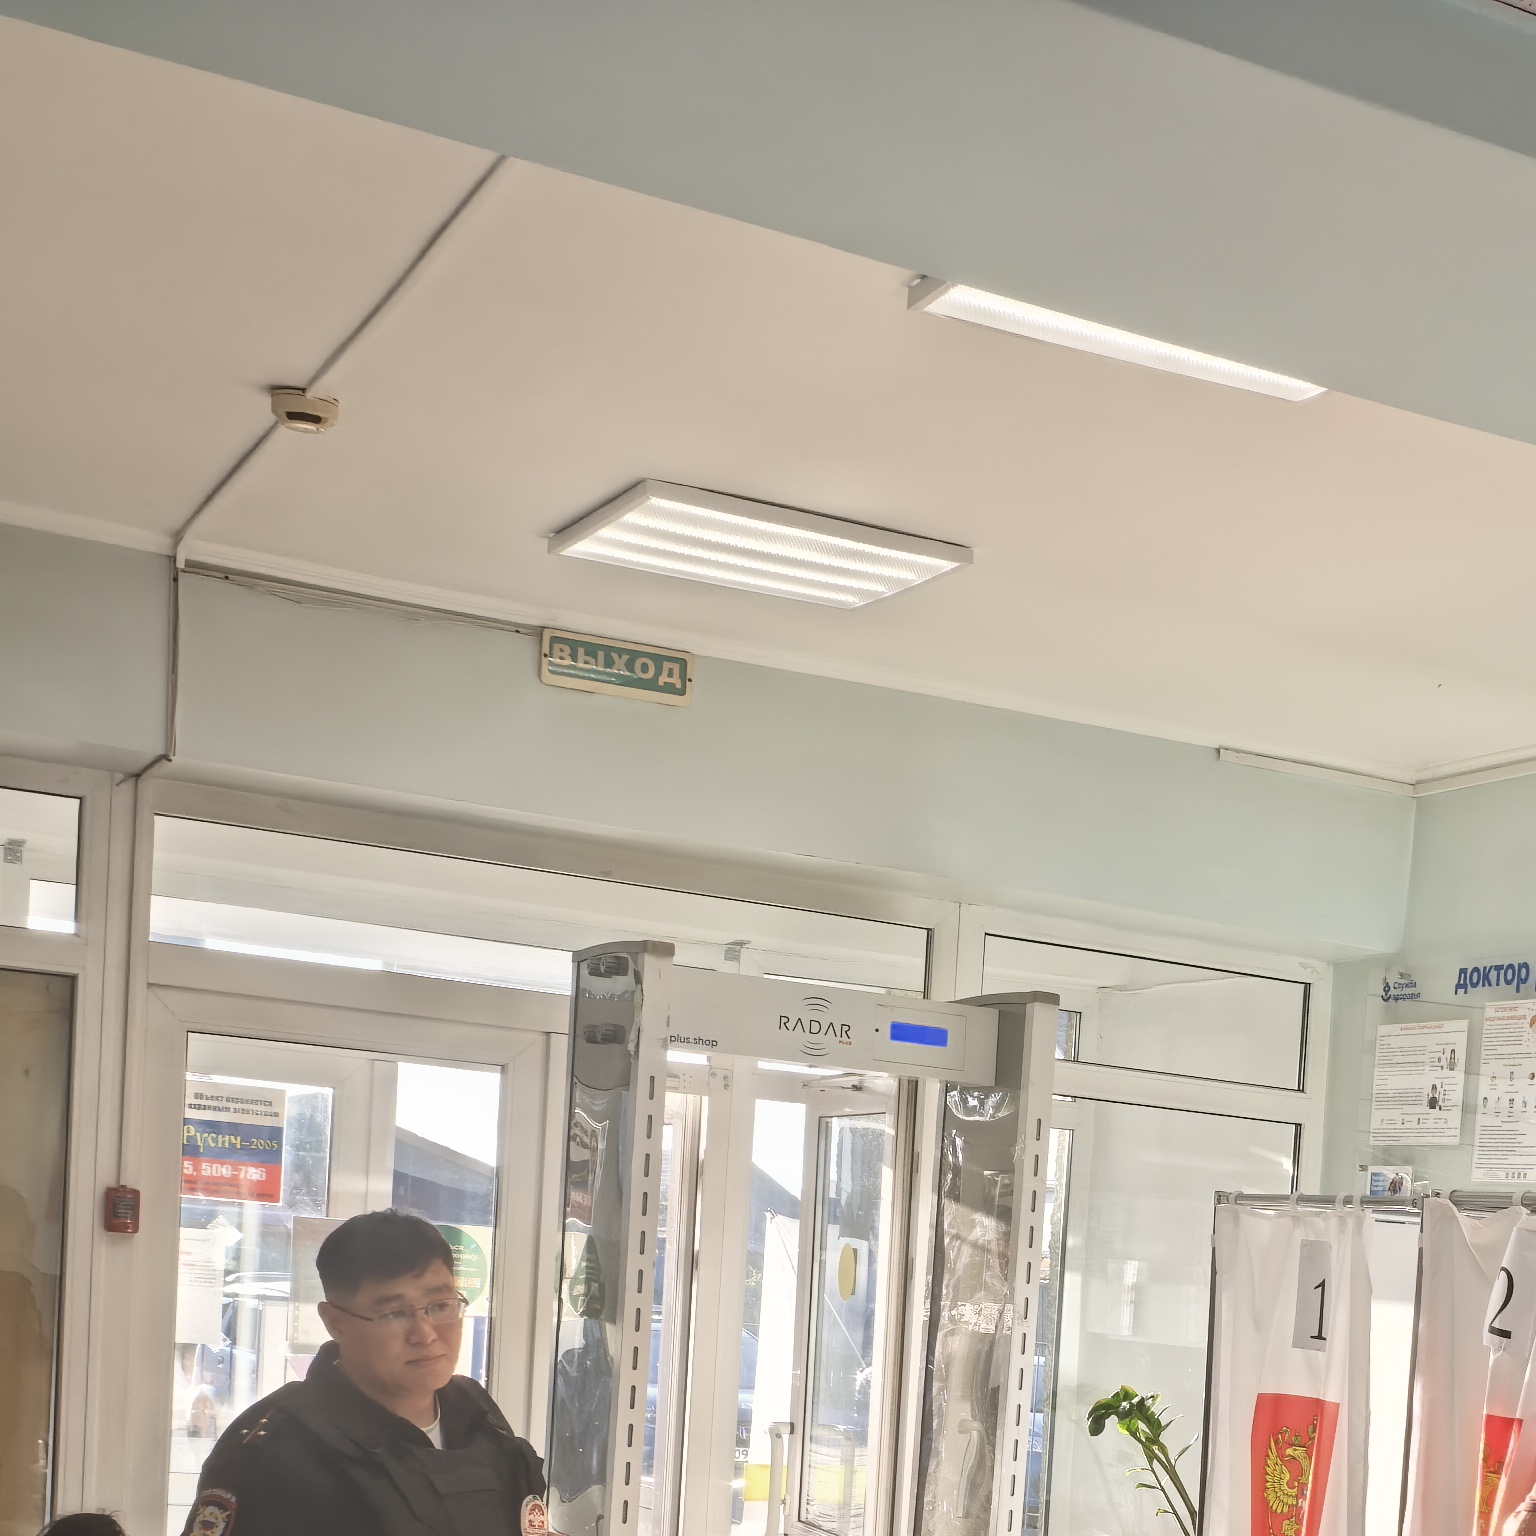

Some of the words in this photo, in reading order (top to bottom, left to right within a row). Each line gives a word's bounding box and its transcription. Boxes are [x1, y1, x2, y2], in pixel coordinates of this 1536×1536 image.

[552, 643, 682, 689] ВЫХОД
[1454, 962, 1530, 996] доктор
[669, 1034, 718, 1049] plus.shop
[778, 1015, 851, 1040] RADAR
[1309, 1278, 1327, 1341] 1
[1487, 1266, 1515, 1340] 2
